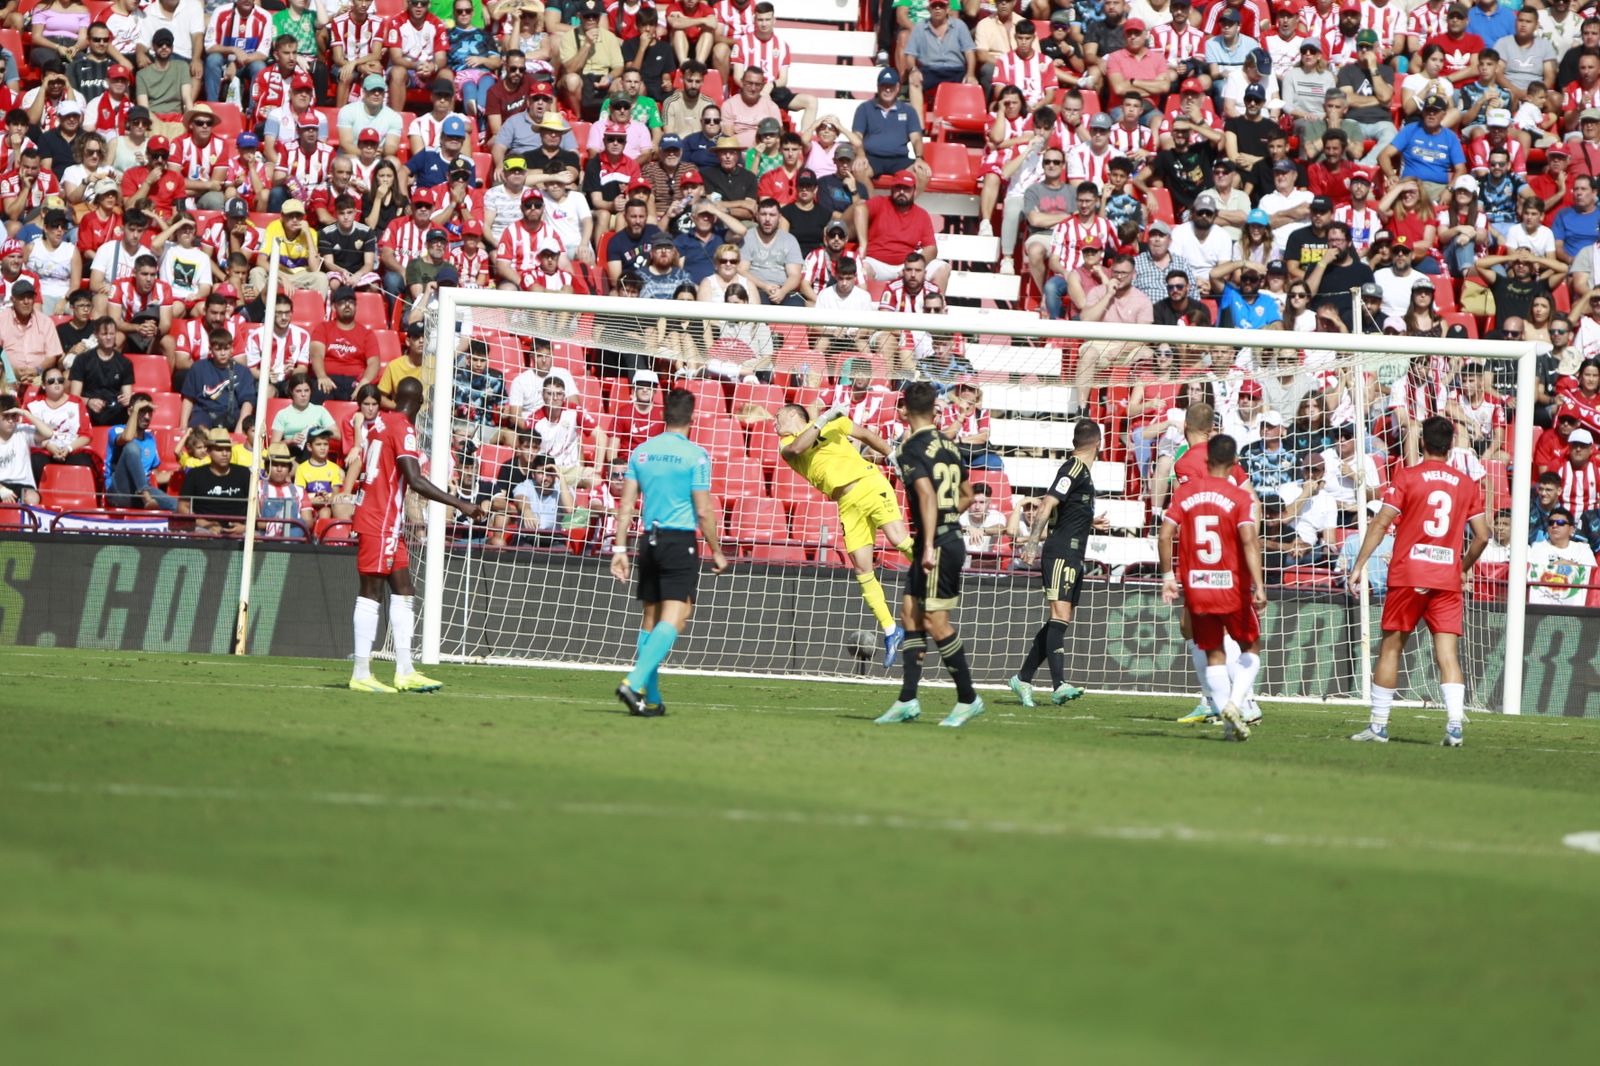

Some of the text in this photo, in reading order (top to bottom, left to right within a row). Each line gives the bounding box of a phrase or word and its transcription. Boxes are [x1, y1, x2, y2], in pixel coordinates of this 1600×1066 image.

[1422, 470, 1460, 486] MELERO
[1181, 491, 1236, 513] ROBERTONE
[1423, 490, 1452, 538] 3
[1194, 515, 1223, 564] 5
[1063, 566, 1076, 584] 10
